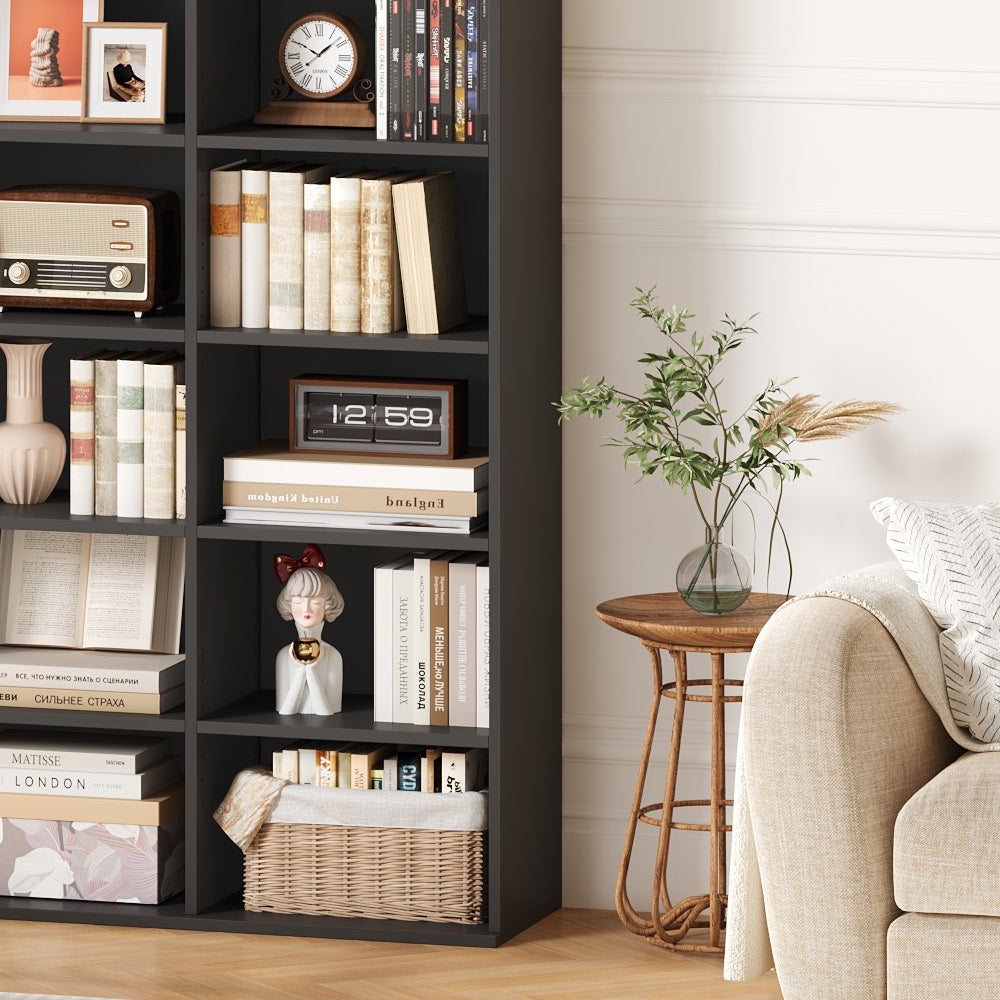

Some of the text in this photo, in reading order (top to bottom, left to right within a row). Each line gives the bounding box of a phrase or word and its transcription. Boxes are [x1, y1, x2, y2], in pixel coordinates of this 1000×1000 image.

[331, 404, 434, 427] 12 59
[399, 596, 408, 632] ЗАБОТА
[45, 674, 72, 682] НУЖНО
[73, 675, 94, 683] ЗНАТЬ
[417, 662, 426, 710] ШОКОЛАД
[34, 694, 83, 706] СИЛЬНЕЕ
[87, 697, 125, 708] СТРАХА
[434, 680, 445, 712] ЛУЧШЕ
[11, 753, 61, 767] MATISSE
[15, 775, 86, 790] LONDON
[402, 764, 417, 790] CYD
